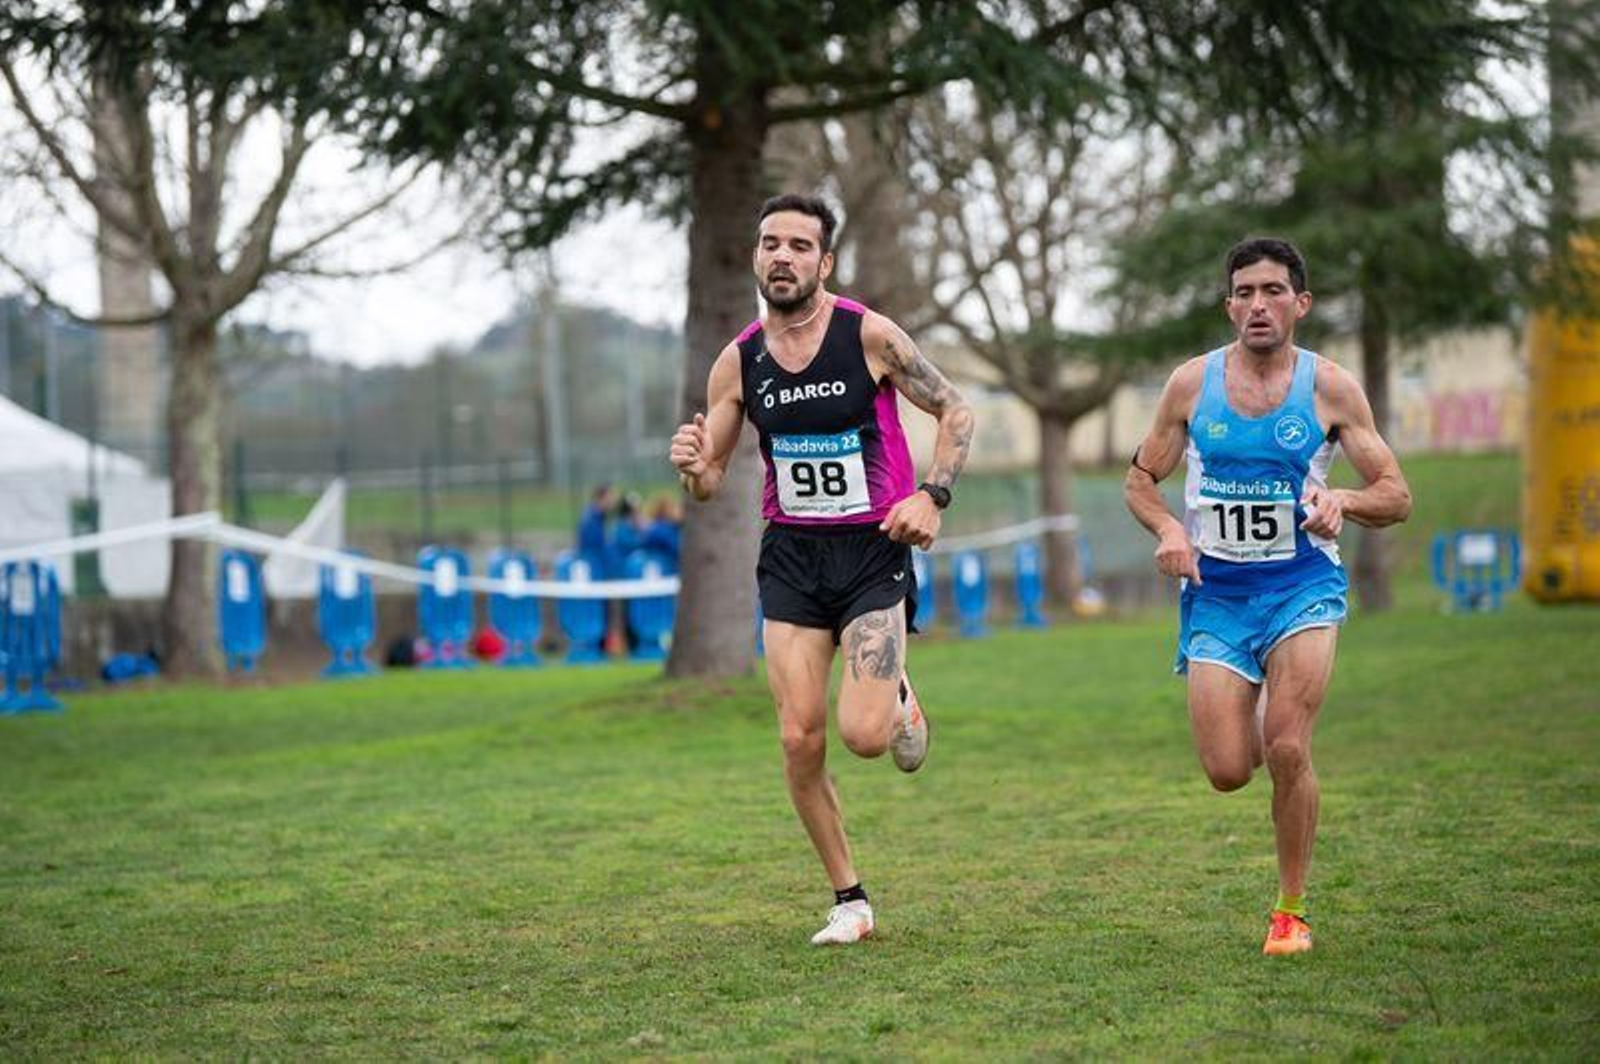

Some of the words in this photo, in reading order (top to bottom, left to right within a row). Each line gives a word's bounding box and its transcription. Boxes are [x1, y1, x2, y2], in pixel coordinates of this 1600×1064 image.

[779, 381, 846, 404] BARCO
[771, 435, 838, 453] Ribadavia
[841, 435, 860, 449] 22
[791, 461, 847, 497] 98
[1201, 477, 1270, 495] Ribadavia
[1273, 480, 1292, 494] 22
[1212, 503, 1278, 542] 115
